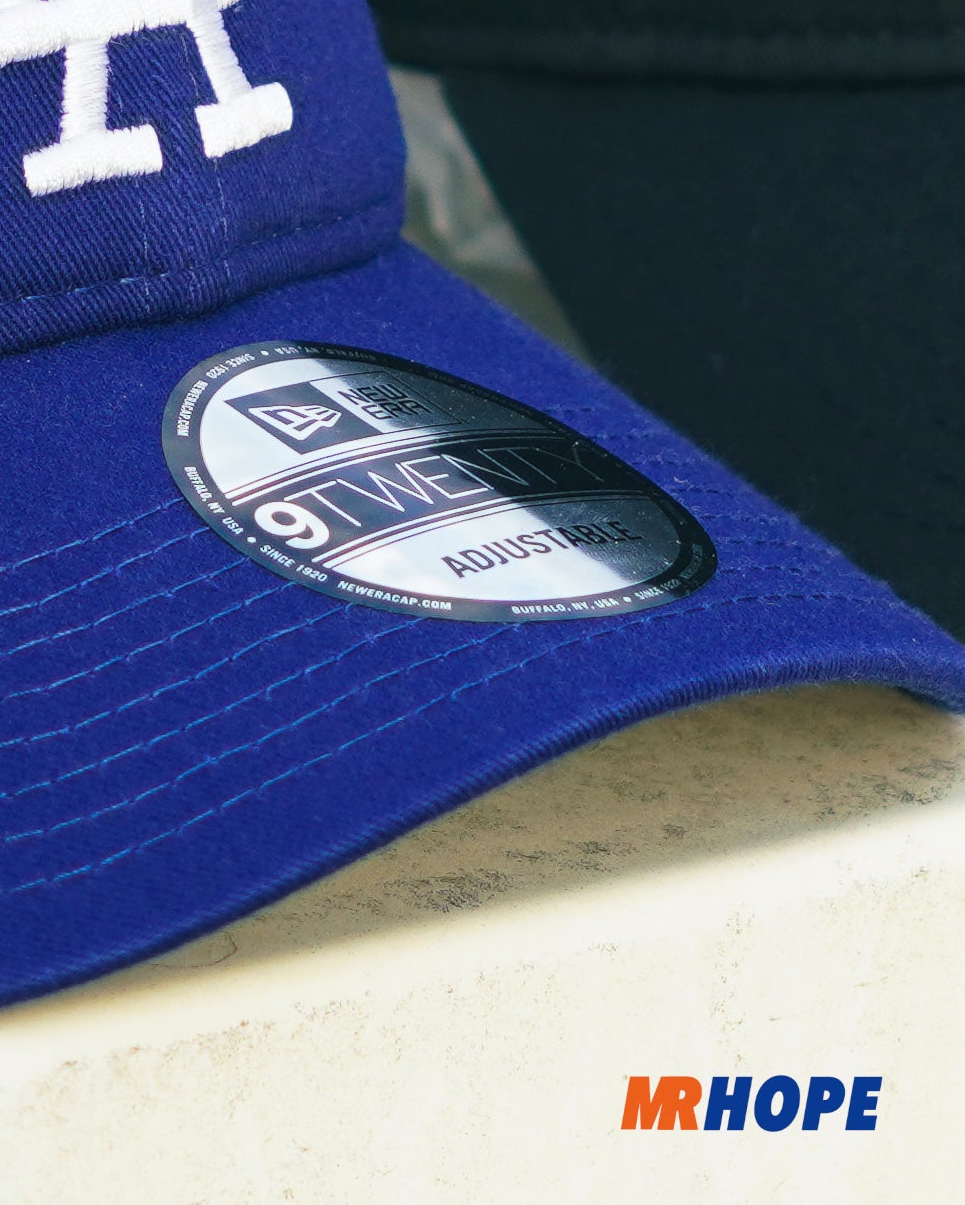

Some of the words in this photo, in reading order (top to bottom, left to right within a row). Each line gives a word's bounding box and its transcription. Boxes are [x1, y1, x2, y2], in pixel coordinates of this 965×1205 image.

[338, 383, 409, 405] NEW
[361, 398, 433, 420] ERA
[441, 520, 645, 579] ADJUSTABLE
[221, 516, 244, 535] USA
[259, 544, 296, 568] SINCE
[296, 564, 328, 582] 1920
[337, 580, 452, 611] NEWERACAP.COM
[594, 597, 620, 608] USA
[634, 586, 664, 600] SINCE
